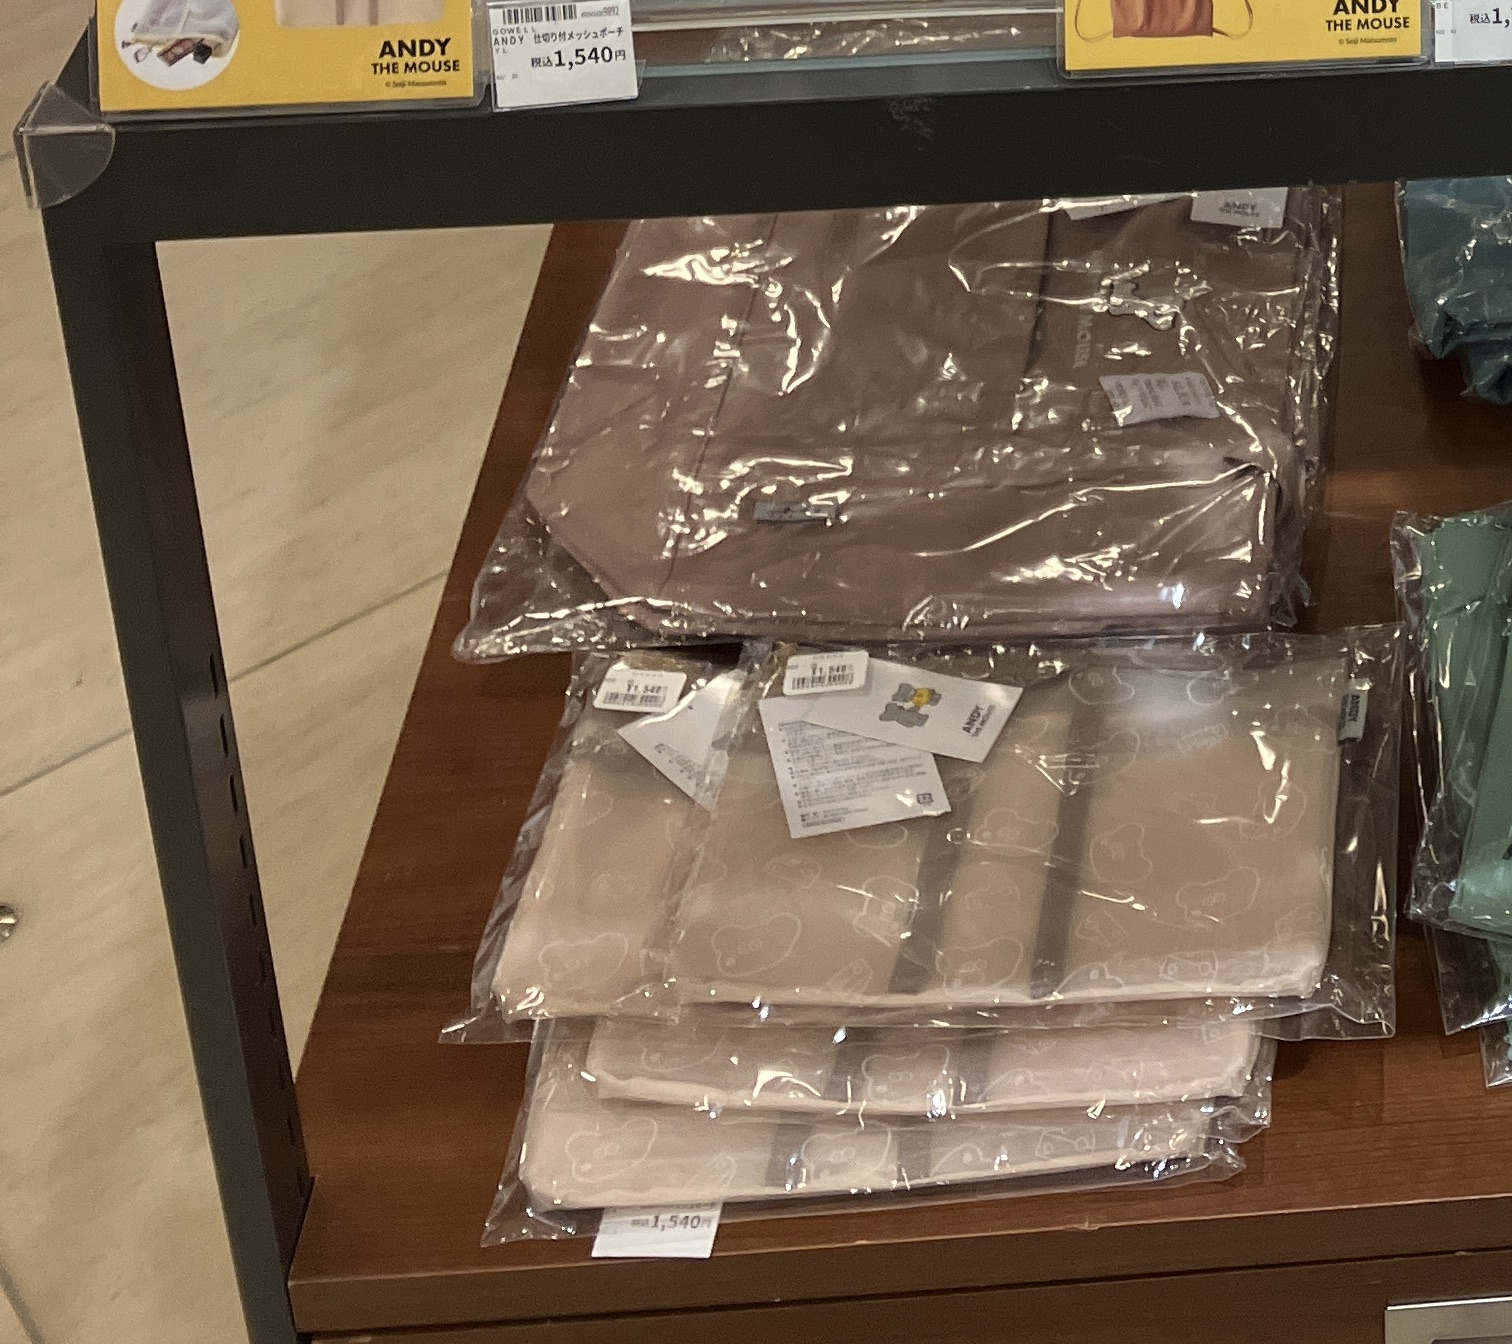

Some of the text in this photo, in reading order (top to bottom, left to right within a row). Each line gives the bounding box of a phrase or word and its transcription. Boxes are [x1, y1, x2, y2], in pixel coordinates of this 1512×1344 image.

[1326, 17, 1410, 31] THE MOUSE
[494, 36, 524, 45] ANDY
[379, 38, 451, 58] ANDY
[371, 60, 460, 74] THE MOUSE
